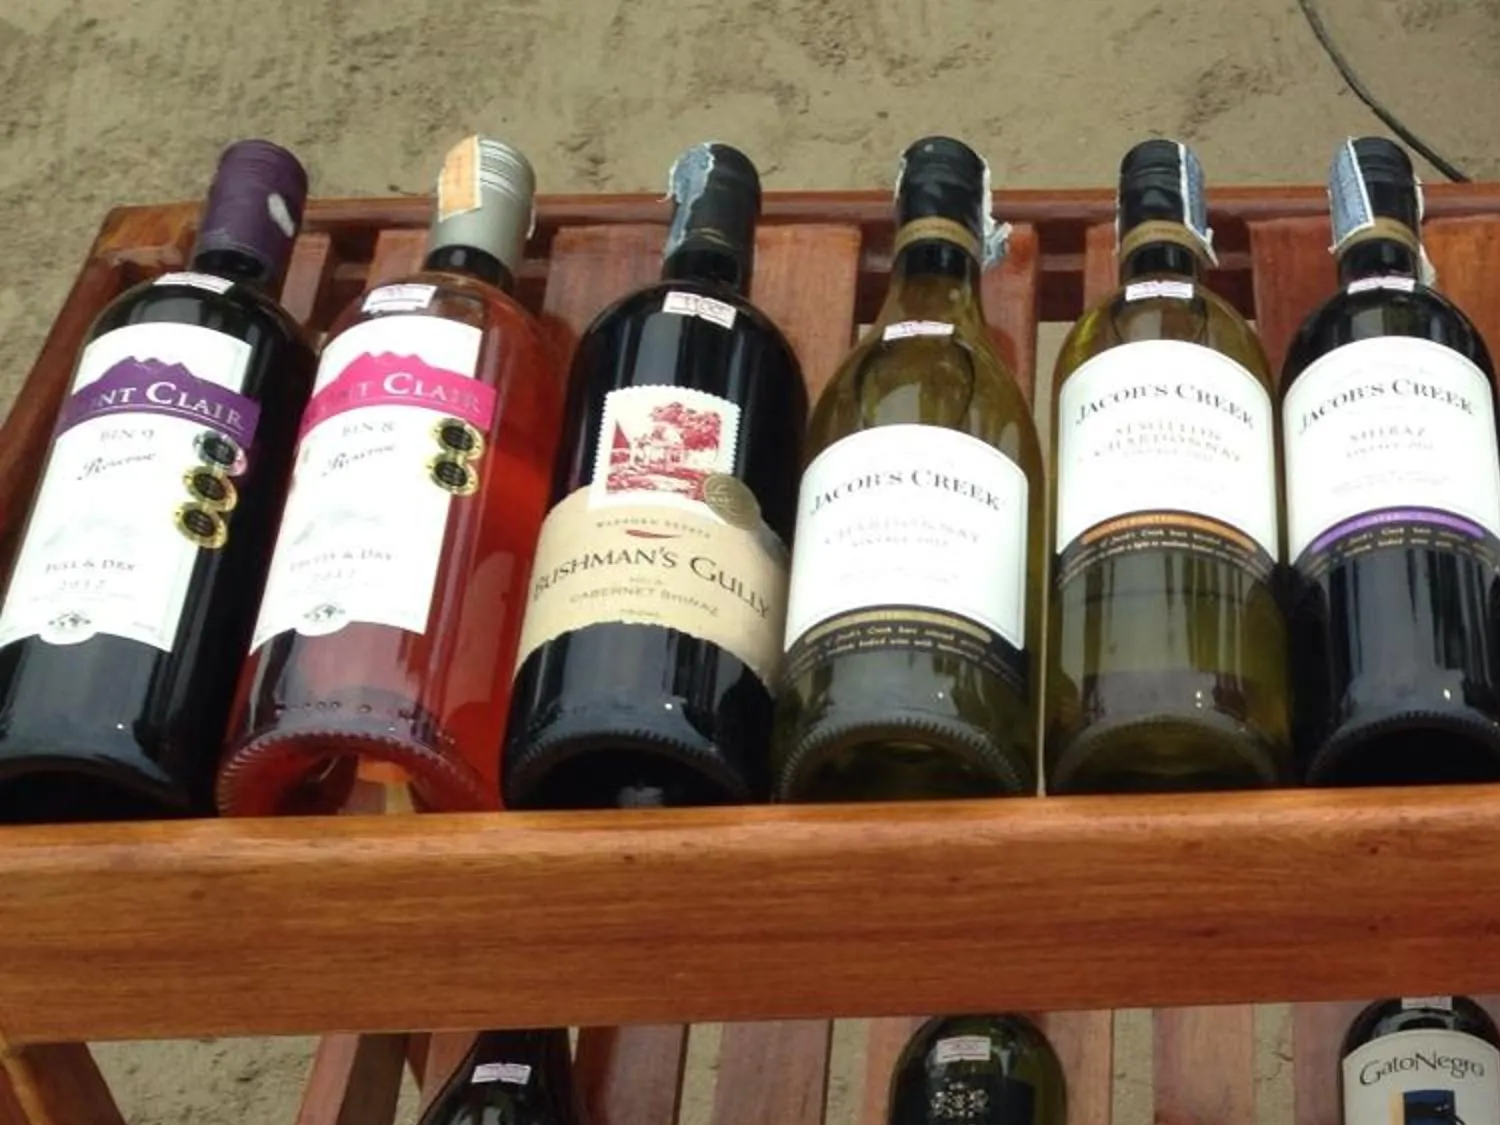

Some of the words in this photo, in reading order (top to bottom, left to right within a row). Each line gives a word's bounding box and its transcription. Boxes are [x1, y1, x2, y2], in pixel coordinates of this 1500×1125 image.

[146, 381, 245, 430] CLAIR
[1073, 384, 1168, 425] JACOB'S
[1175, 384, 1253, 429] CREEK
[1297, 383, 1384, 435] JACOB'S
[1392, 379, 1474, 416] CREEK
[809, 472, 903, 515] JACOB'S
[911, 469, 1000, 511] CREEK
[532, 546, 679, 601] BUSHMAN'S
[690, 556, 770, 619] GULLY
[570, 586, 655, 603] CABERNET
[660, 588, 719, 616] SHIRAZ
